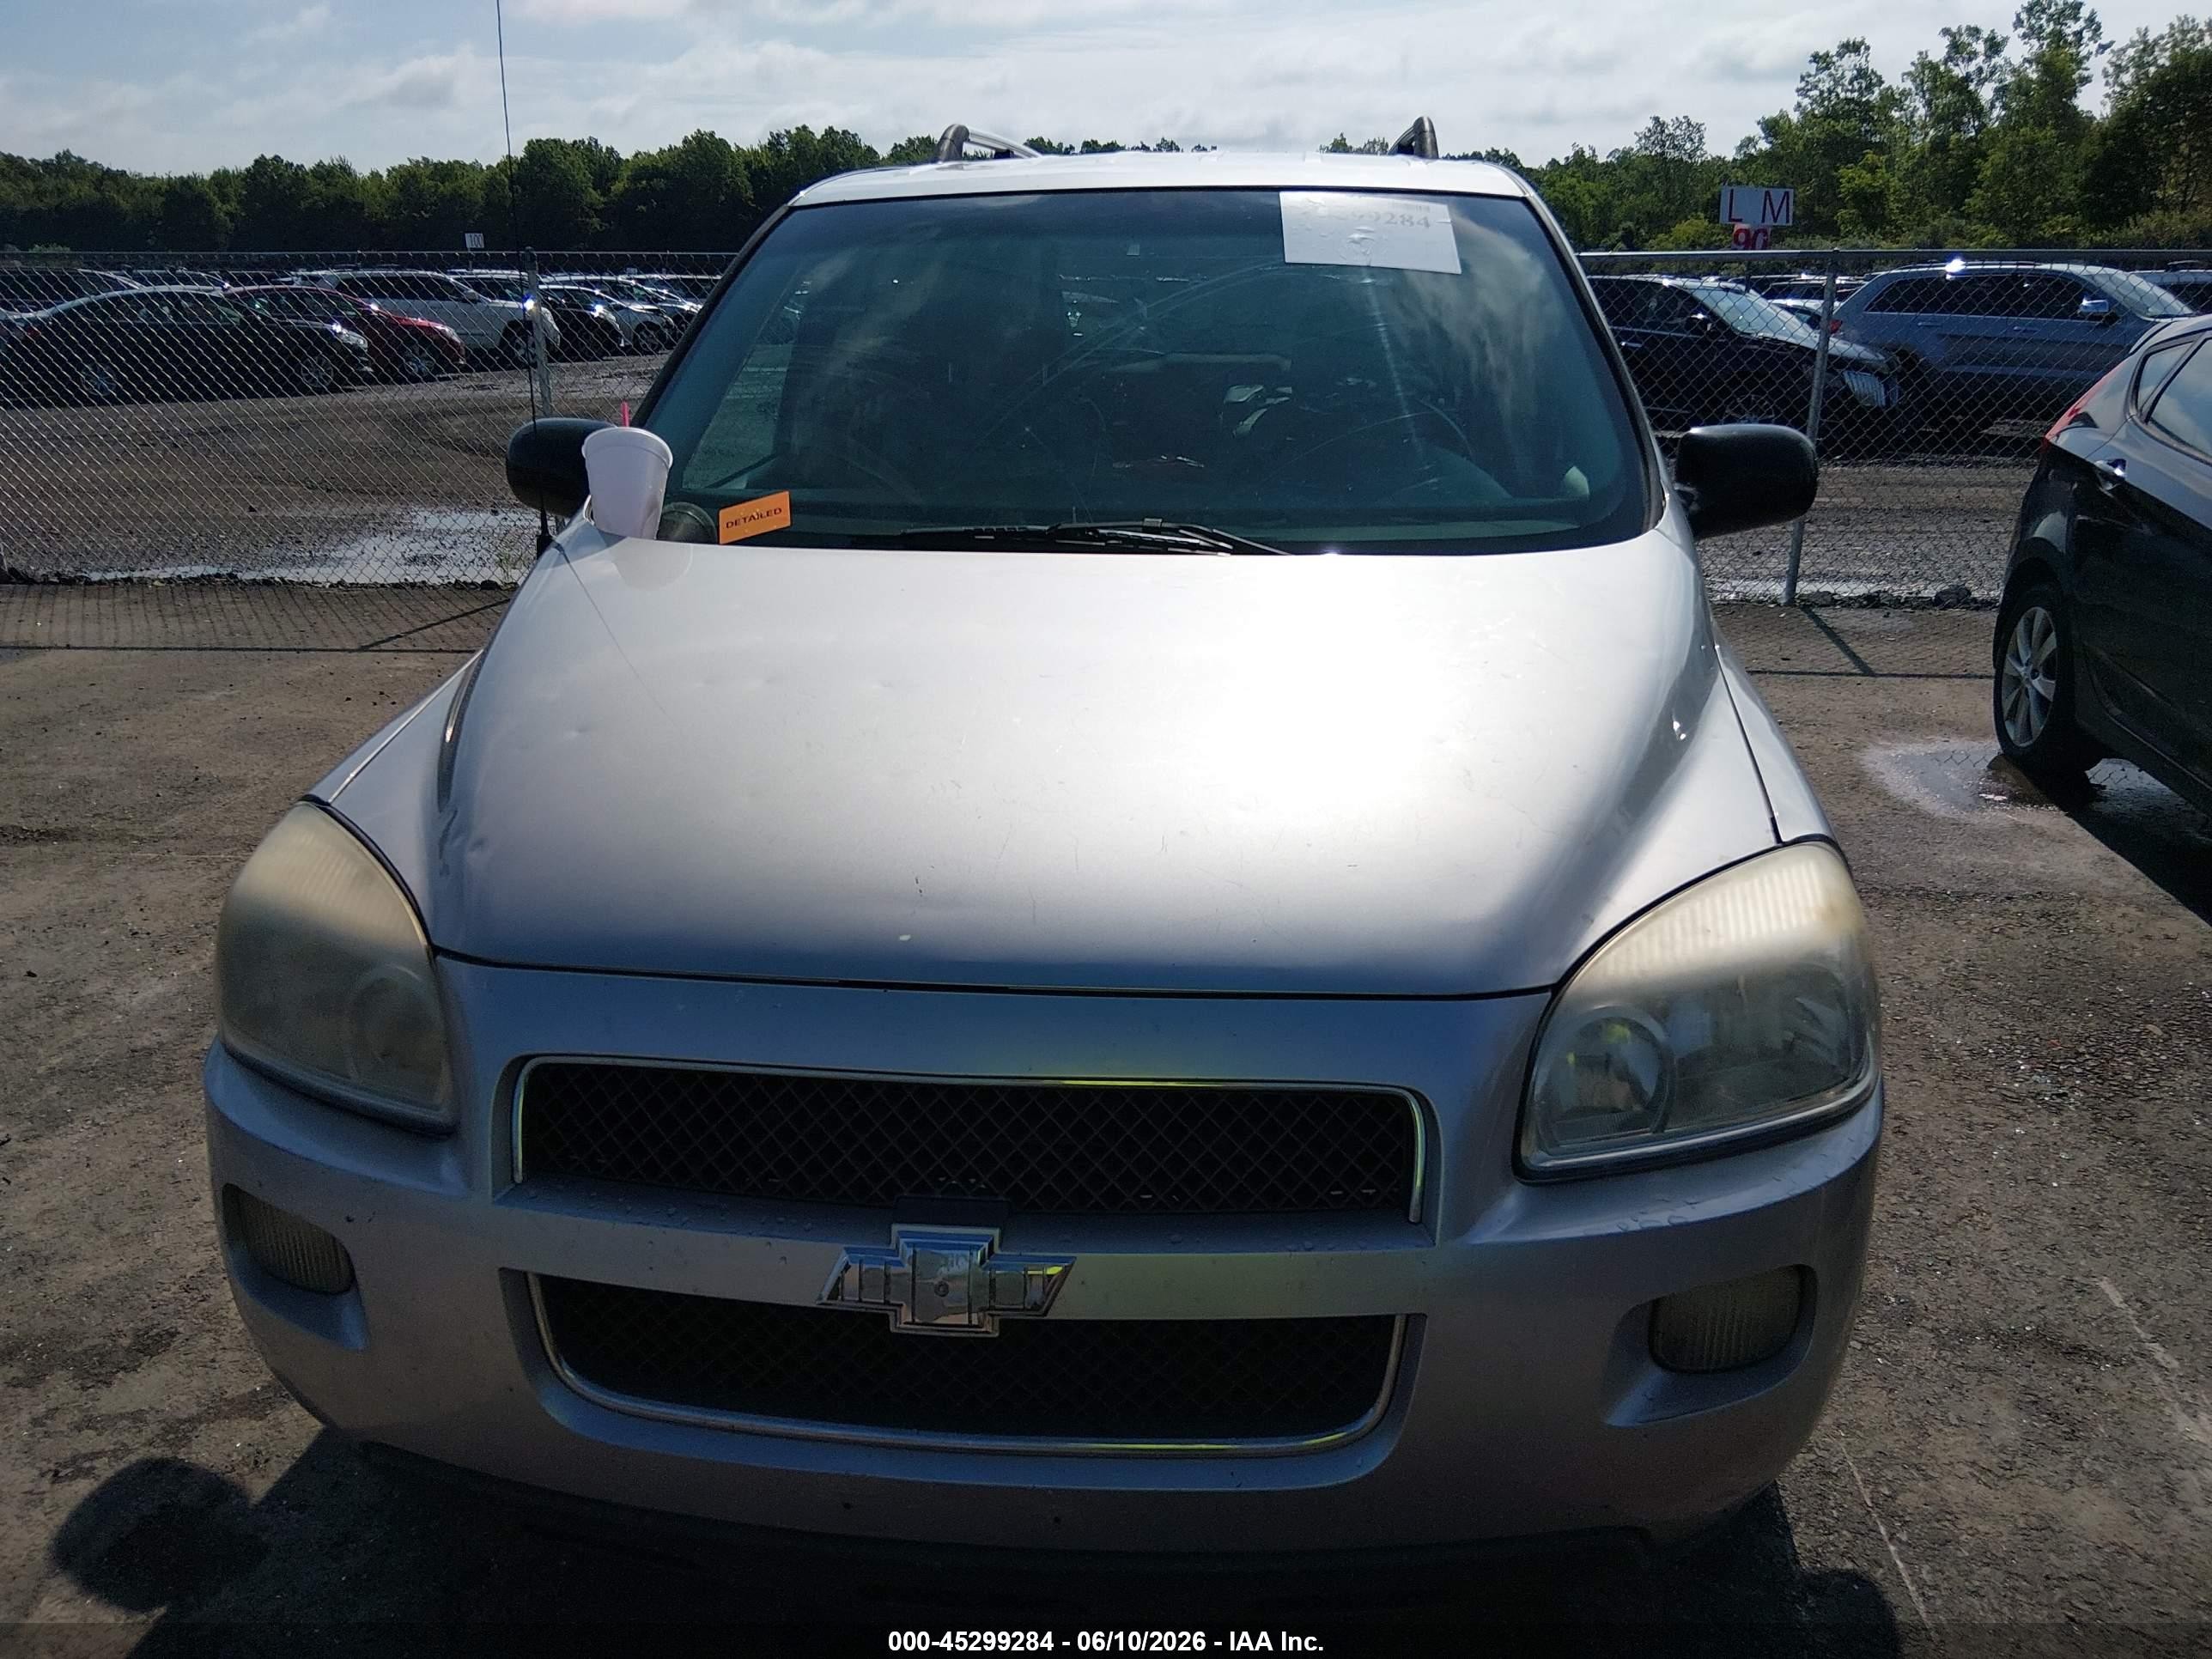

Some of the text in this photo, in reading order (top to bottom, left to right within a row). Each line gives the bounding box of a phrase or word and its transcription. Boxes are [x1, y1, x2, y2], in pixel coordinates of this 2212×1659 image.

[1728, 189, 1790, 223] L M
[726, 507, 782, 529] DETAILED
